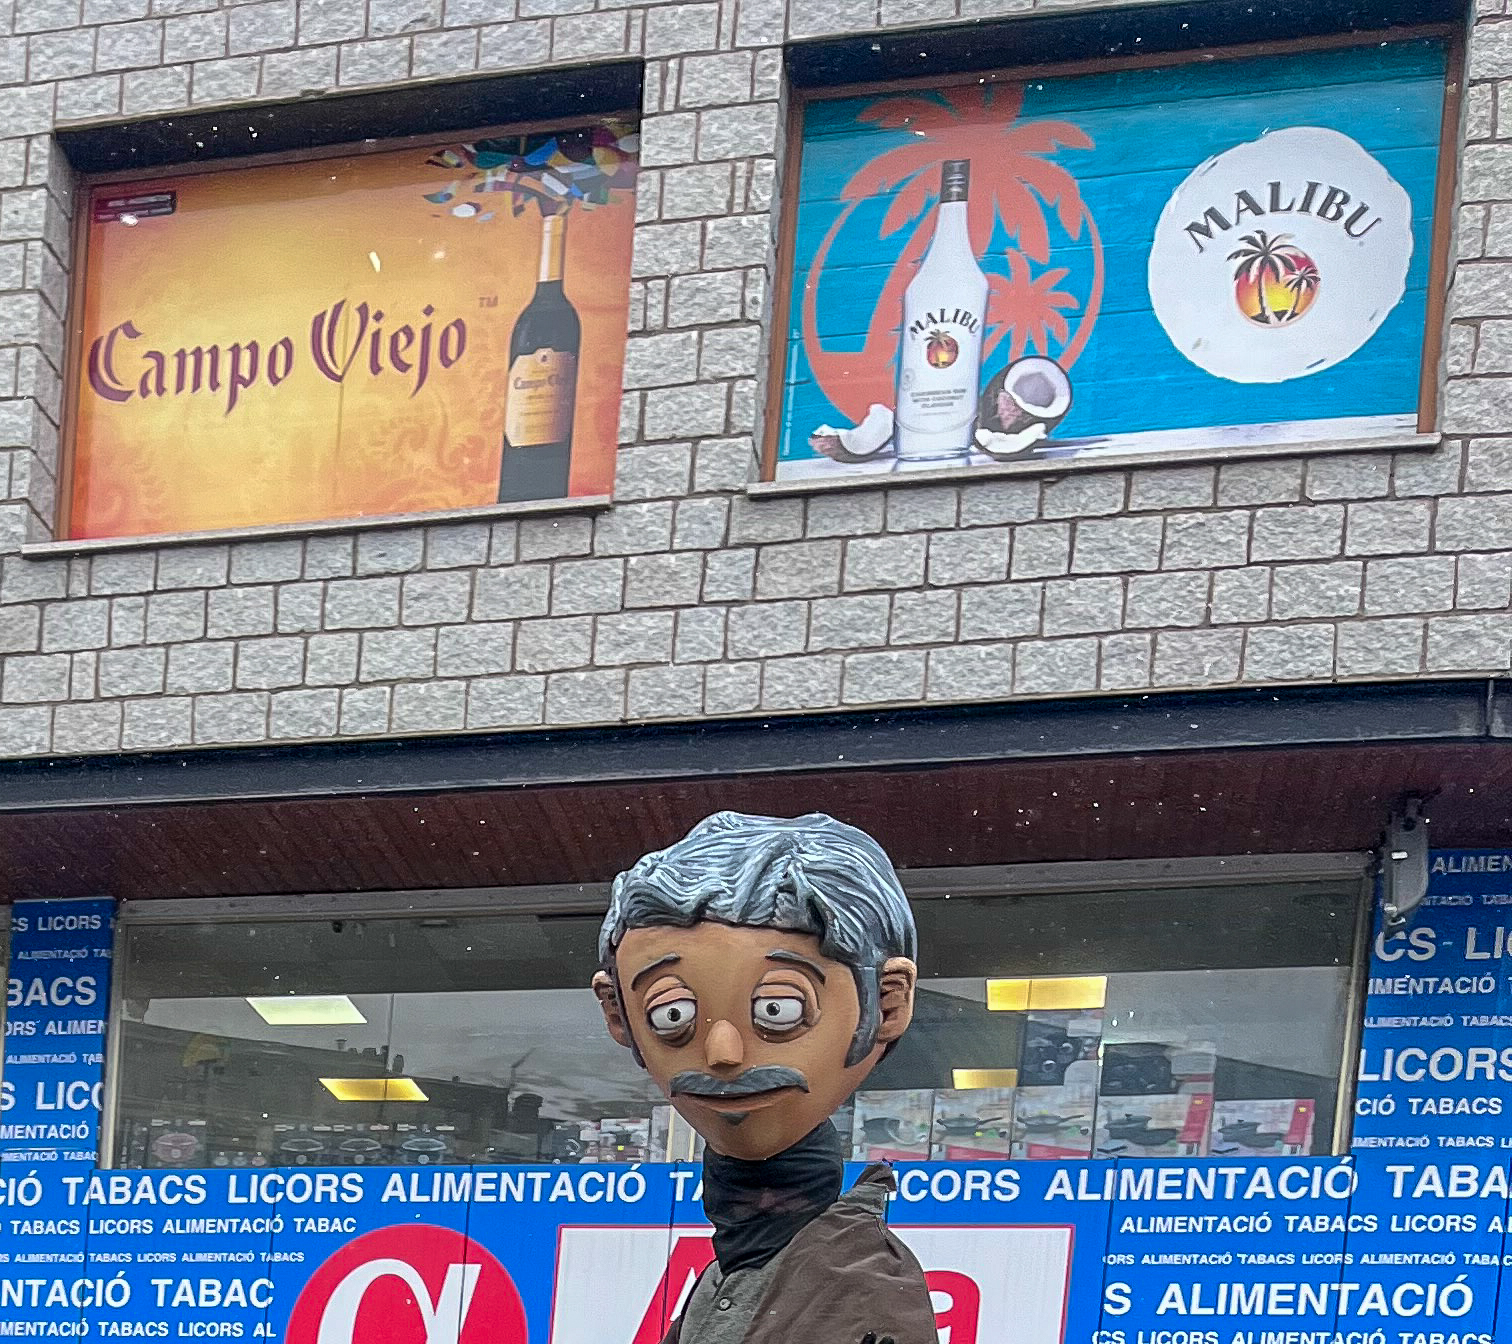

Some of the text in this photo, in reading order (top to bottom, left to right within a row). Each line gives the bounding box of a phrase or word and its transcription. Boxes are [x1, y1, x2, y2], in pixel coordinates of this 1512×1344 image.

[1184, 180, 1386, 253] MALIBU
[909, 308, 981, 341] MALIBU
[88, 320, 294, 417] Campo
[311, 300, 467, 398] Viejo
[38, 915, 101, 930] LICORS
[18, 949, 88, 962] ALIMENTACIÓ
[6, 976, 97, 1007] BACS
[6, 1052, 77, 1064] ALIMENTACIÓ
[1409, 1098, 1502, 1114] TABACS
[1438, 1136, 1494, 1147] TABACS
[62, 1175, 206, 1205] TABACS
[228, 1173, 363, 1203] LICORS
[381, 1163, 646, 1202] ALIMENTACIÓ
[1044, 1156, 1358, 1200] ALIMENTACIÓ
[10, 1220, 80, 1234] TABACS
[89, 1219, 153, 1234] LICORS
[163, 1214, 283, 1233] ALIMENTACIÓ
[294, 1218, 356, 1232] TABAC
[1120, 1212, 1476, 1232] ALIMENTACIÓ TABACS LICORS
[15, 1252, 84, 1262] ALIMENTACIÓ
[90, 1253, 132, 1262] TABACS
[137, 1253, 176, 1262] LICORS
[182, 1250, 254, 1262] ALIMENTACIÓ
[260, 1252, 304, 1262] TABACS
[1142, 1252, 1455, 1264] ALIMENTACIÓ TABACS LICORS ALIMENTACIÓ
[151, 1278, 274, 1308] TABAC
[1104, 1275, 1472, 1316] S ALIMENTACIÓ
[99, 1322, 276, 1337] TABACS LICORS AL
